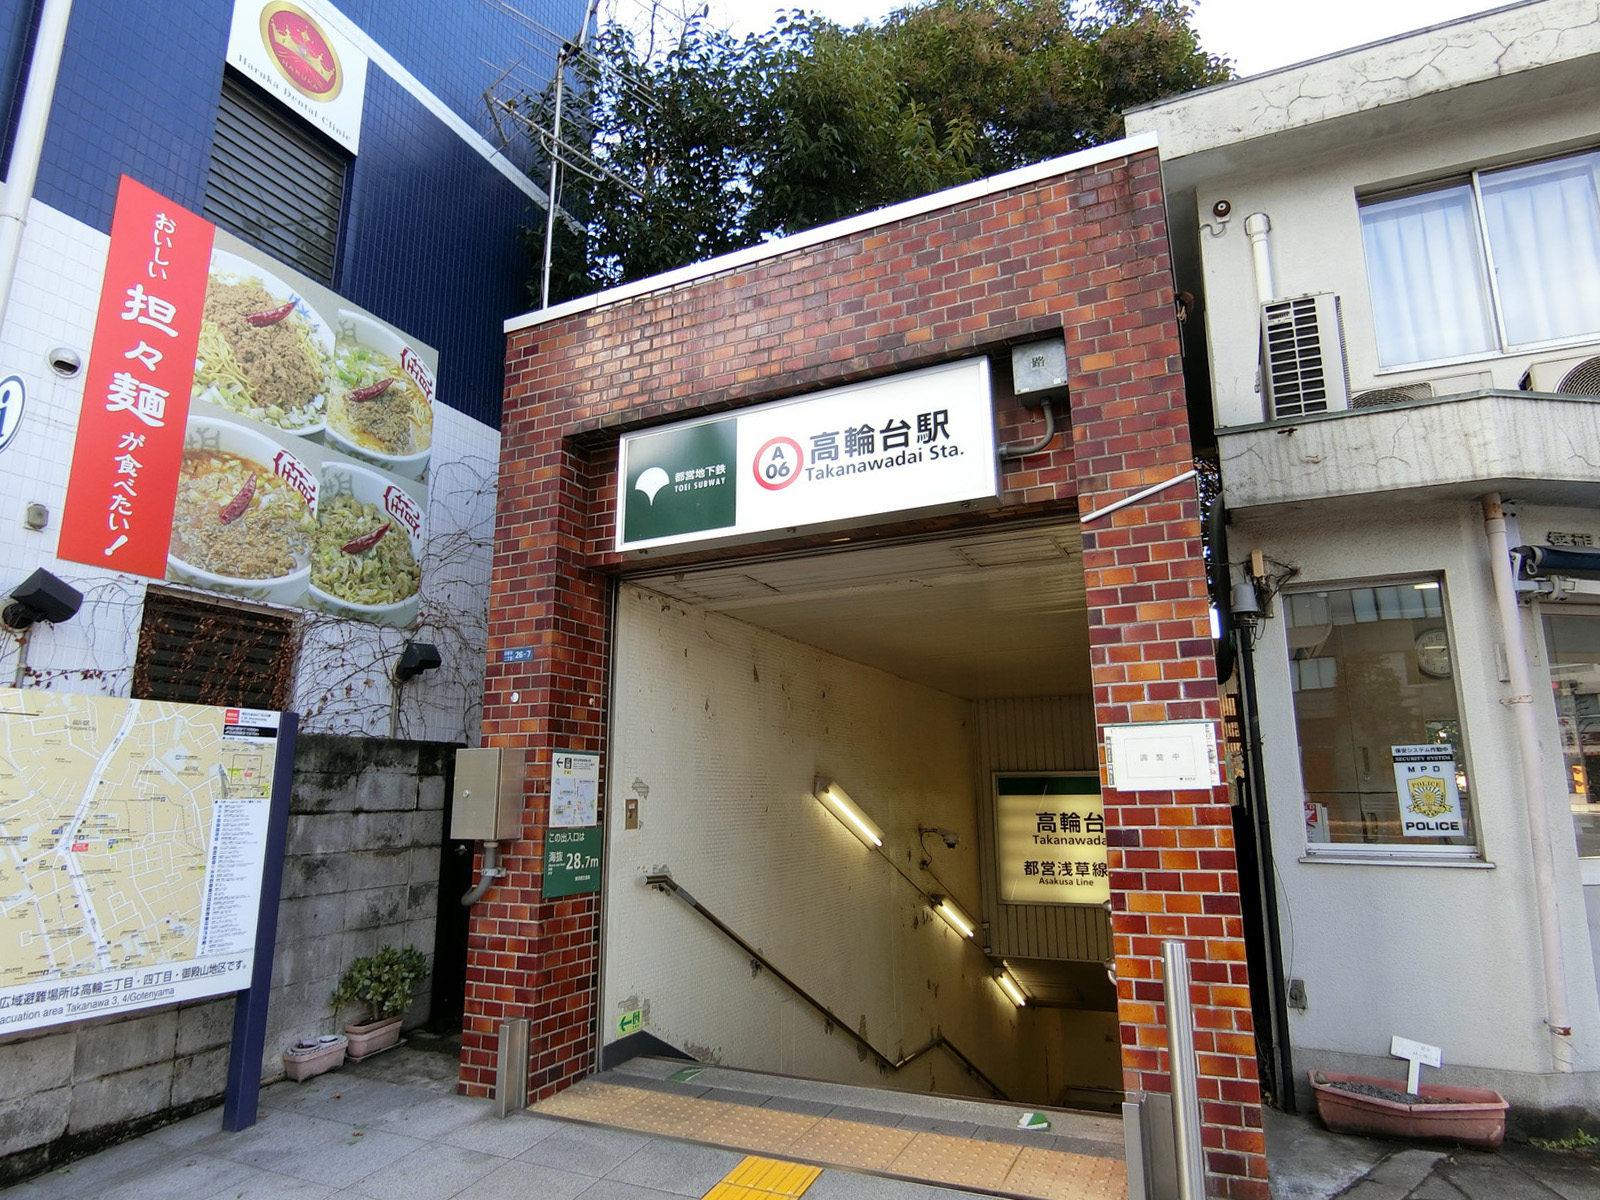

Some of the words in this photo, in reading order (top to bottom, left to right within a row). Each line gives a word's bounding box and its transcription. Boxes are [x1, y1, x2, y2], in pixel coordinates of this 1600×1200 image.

[238, 54, 279, 89] Haruka
[283, 87, 318, 118] Dental
[321, 115, 351, 141] Clinic
[148, 213, 177, 280] おいしい
[105, 283, 179, 428] 担々麺
[809, 408, 951, 465] 高輪台駅
[771, 446, 785, 461] A
[805, 447, 923, 481] Takanawadai
[929, 444, 965, 461] Sta.
[674, 463, 727, 483] 都営地下鉄
[765, 461, 791, 480] 06
[674, 483, 691, 493] TOEI
[693, 476, 726, 490] SUBWAY
[515, 649, 532, 659] 26-7
[1411, 780, 1442, 788] POLICE
[1035, 811, 1104, 834] 高輪台
[1405, 821, 1460, 831] POLICE
[548, 832, 585, 843] この出入口は
[547, 851, 563, 864] 海抜
[565, 852, 599, 871] 28.7m
[1024, 860, 1108, 878] 都営浅草線
[1038, 877, 1074, 886] Asakusa
[1075, 877, 1094, 887] Line
[43, 1007, 64, 1017] area
[66, 999, 110, 1014] Takanawa
[111, 995, 120, 1006] 3,
